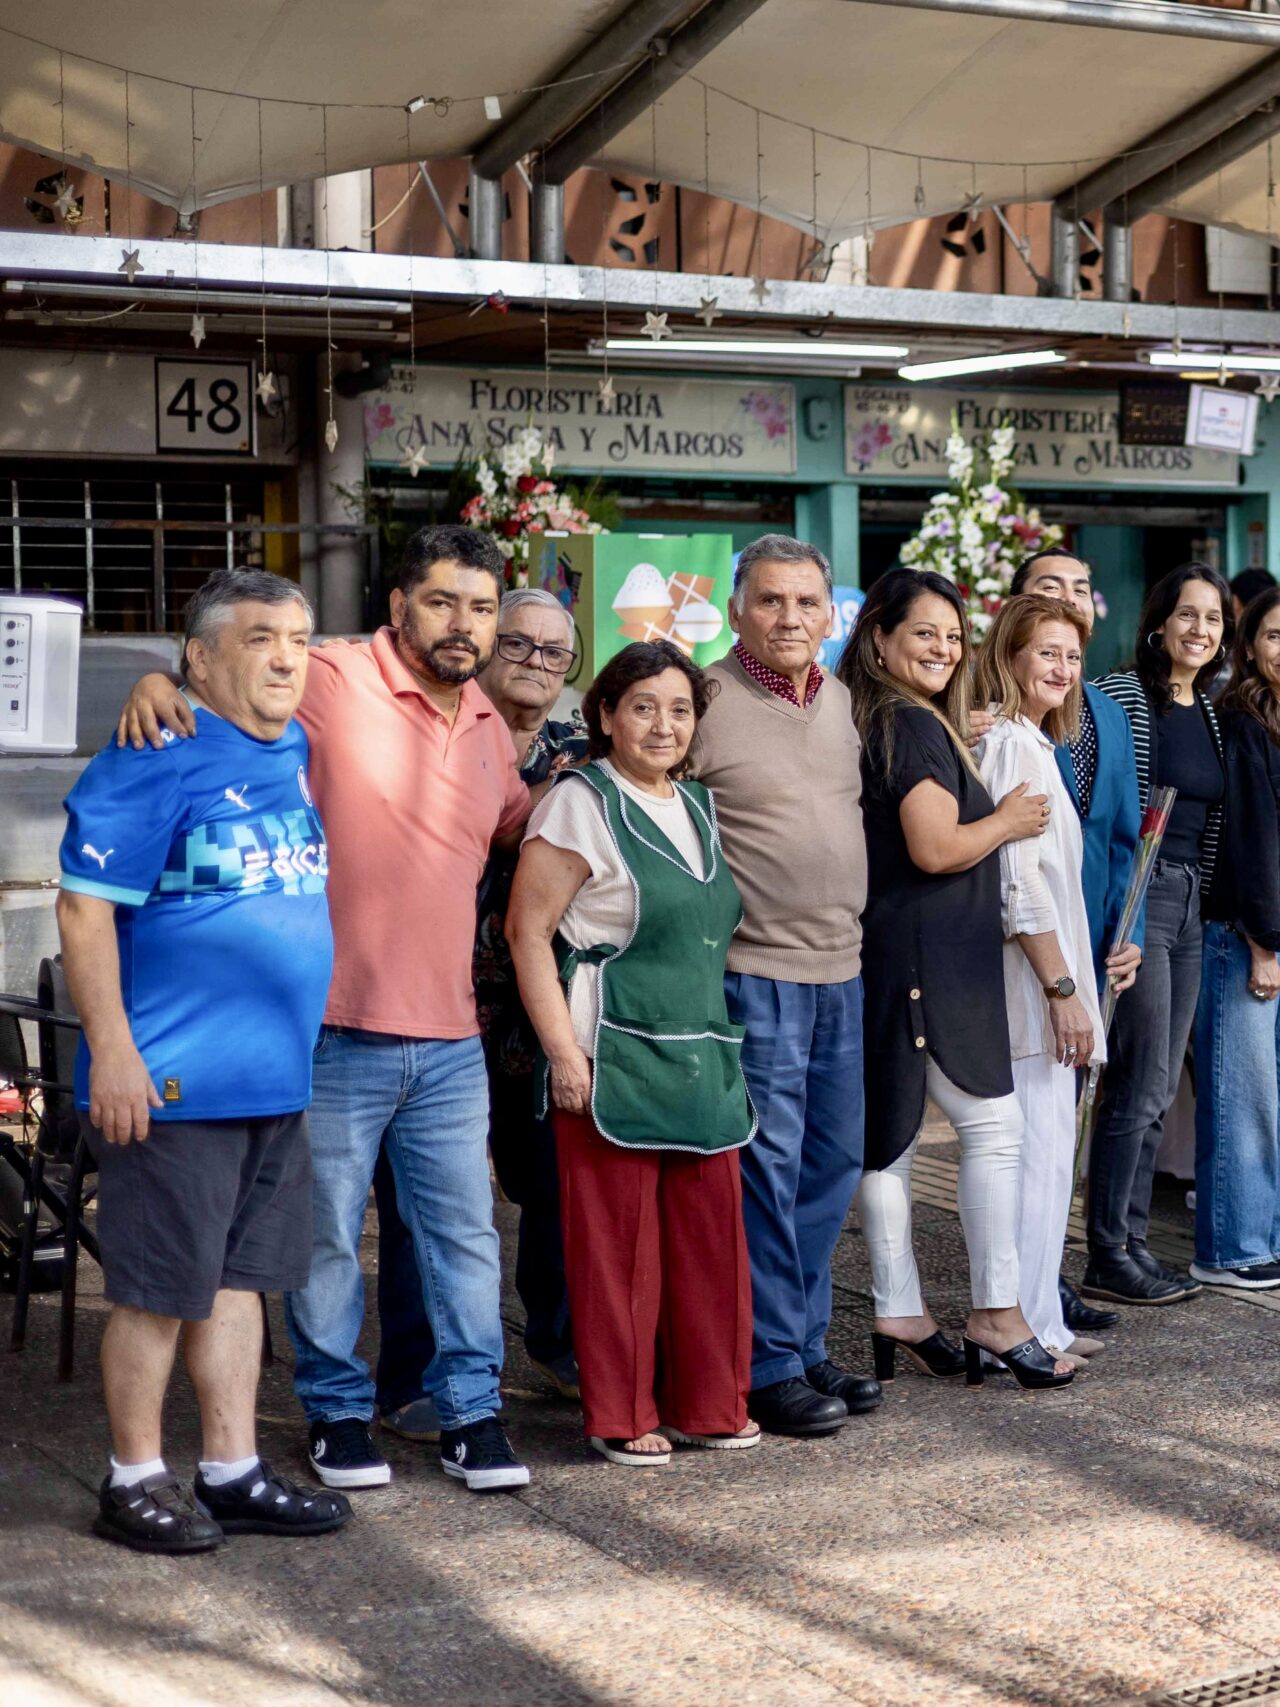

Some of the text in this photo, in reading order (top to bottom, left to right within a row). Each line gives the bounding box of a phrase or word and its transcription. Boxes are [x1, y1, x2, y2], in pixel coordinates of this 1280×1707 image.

[167, 377, 241, 434] 48
[396, 414, 743, 462] ANA SOA Y MARCOS
[892, 433, 948, 469] AN
[1049, 444, 1064, 466] Y
[1073, 440, 1192, 475] MARCOS
